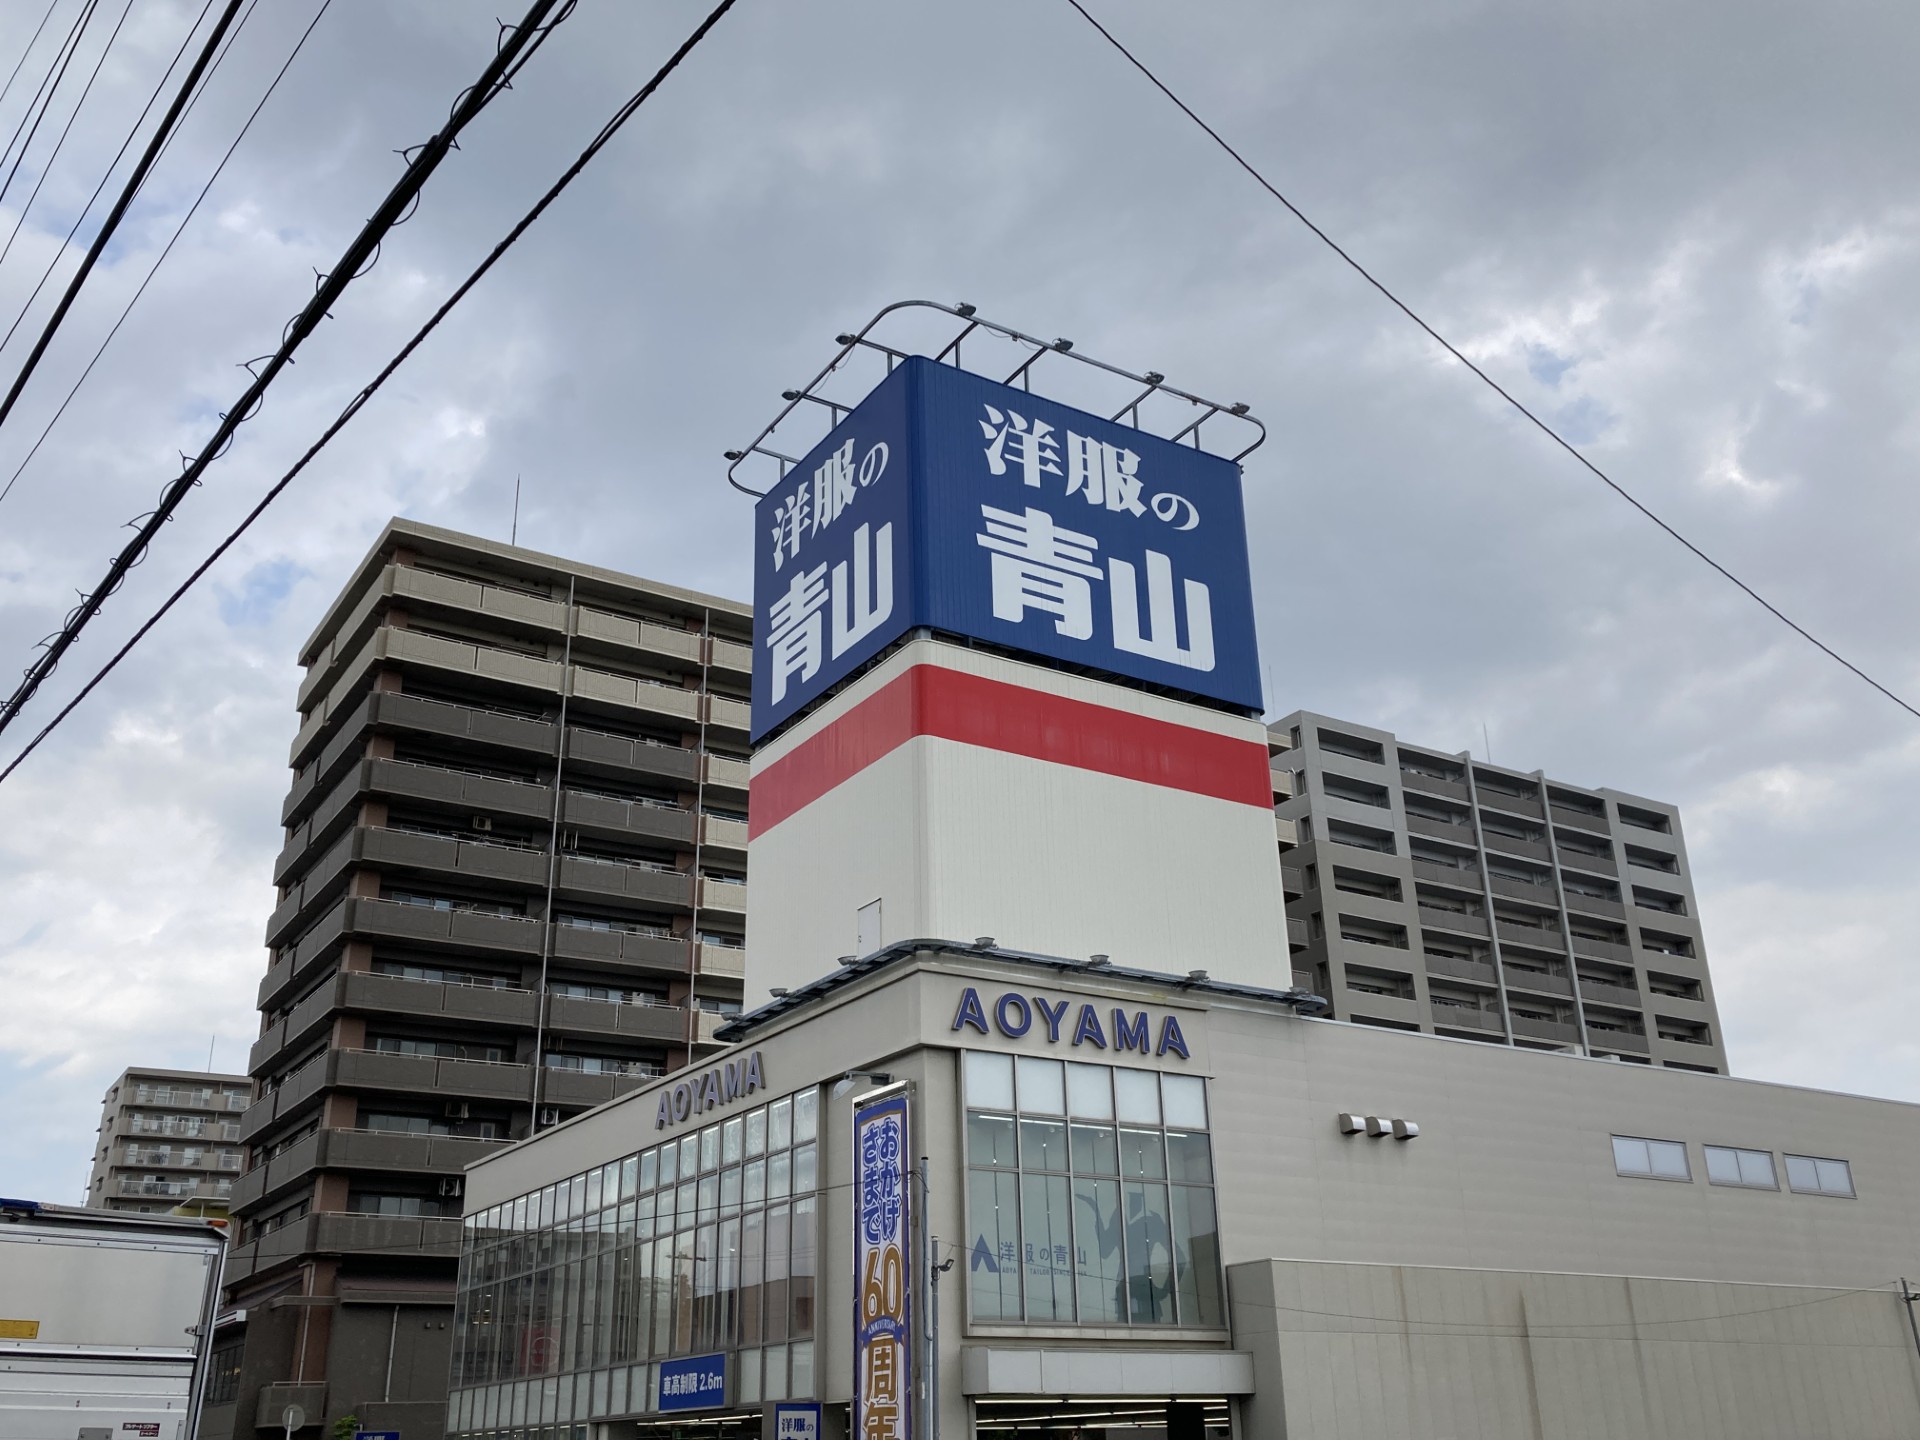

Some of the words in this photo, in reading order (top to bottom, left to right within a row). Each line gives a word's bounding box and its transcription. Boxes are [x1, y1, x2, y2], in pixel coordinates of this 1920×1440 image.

[771, 437, 889, 573] 洋服の
[979, 403, 1200, 531] 洋服の
[766, 521, 893, 706] 青山
[976, 504, 1216, 672] 青山
[952, 987, 1191, 1059] AOYAMA
[655, 1051, 766, 1130] AOYAMA
[862, 1124, 881, 1244] さまで
[879, 1117, 901, 1242] おかげ
[863, 1244, 904, 1326] 60
[663, 1372, 698, 1397] 車高制限
[700, 1372, 723, 1391] 2.6m
[781, 1417, 814, 1433] 洋服の
